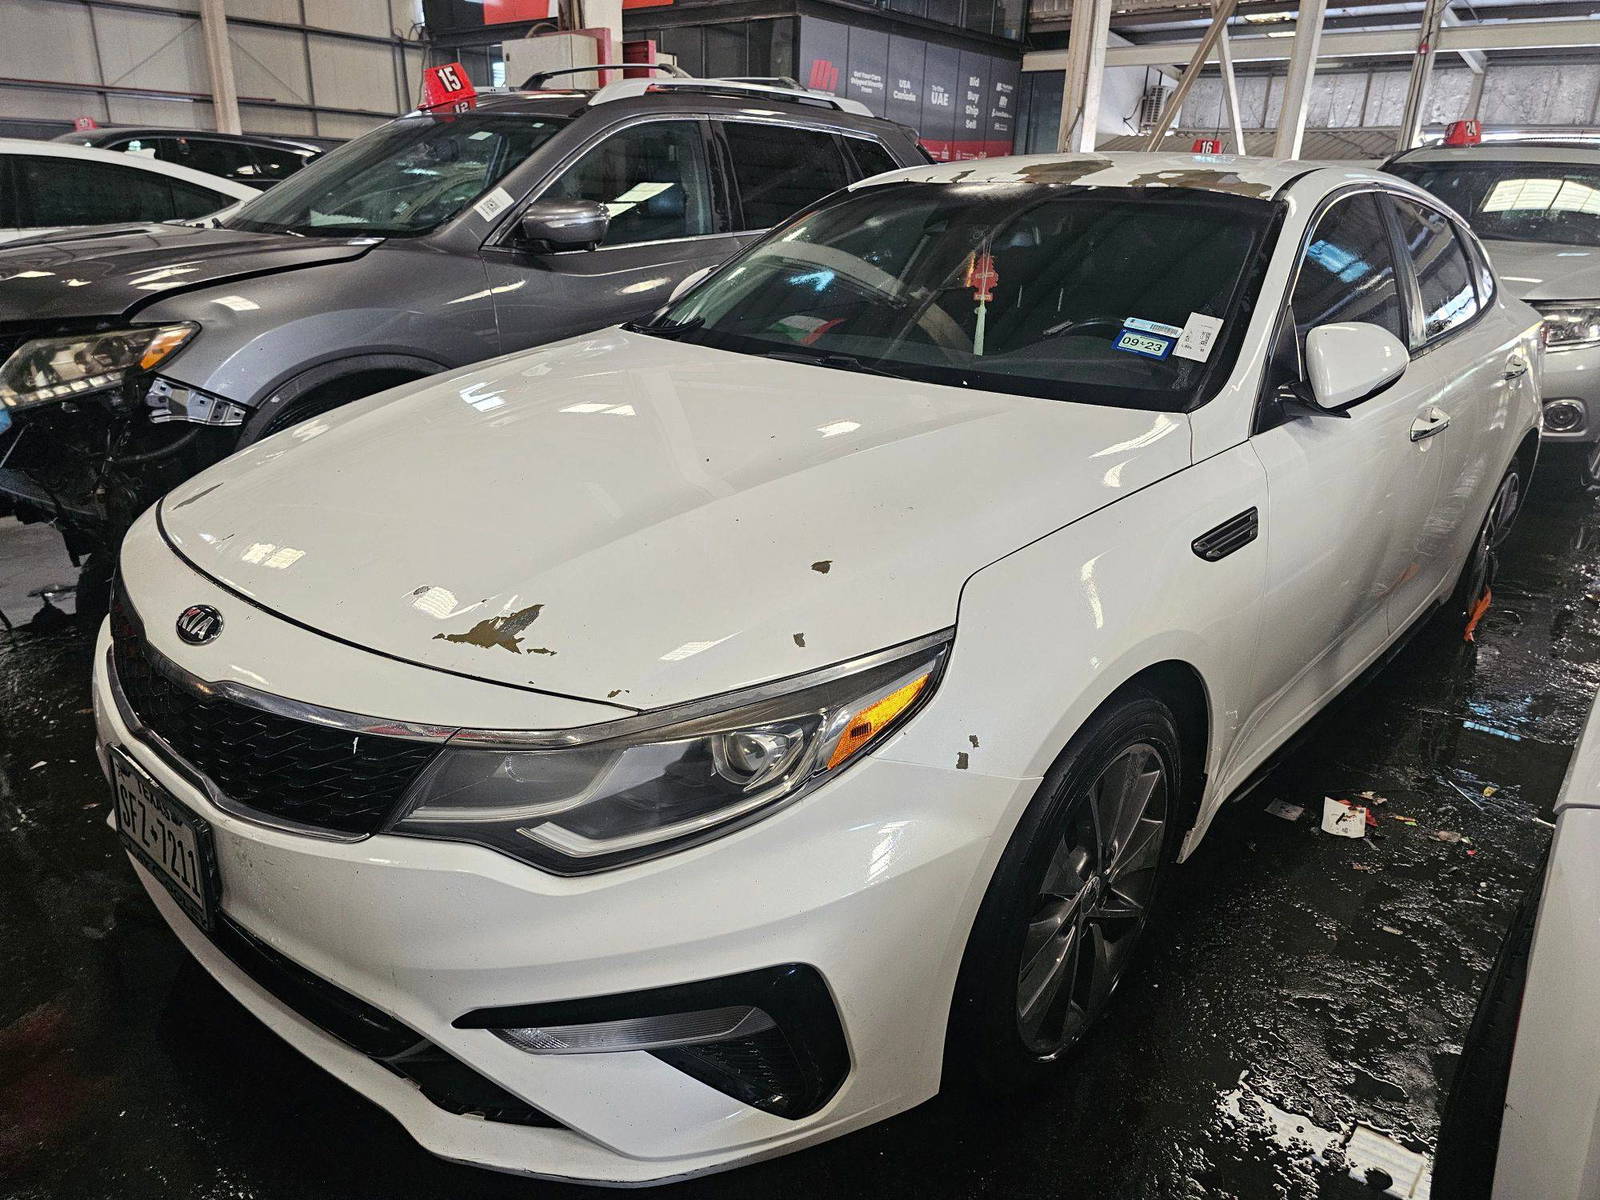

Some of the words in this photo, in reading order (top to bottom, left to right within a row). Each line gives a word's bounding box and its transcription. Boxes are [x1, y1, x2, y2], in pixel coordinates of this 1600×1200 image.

[437, 66, 462, 92] 15
[899, 80, 911, 89] USA
[969, 77, 979, 87] Bid
[893, 90, 916, 101] Canada
[931, 91, 950, 106] UAE
[965, 105, 979, 118] Ship
[965, 119, 977, 130] Sell
[1466, 121, 1477, 137] 24
[1202, 140, 1213, 154] 16
[178, 608, 215, 640] KIA
